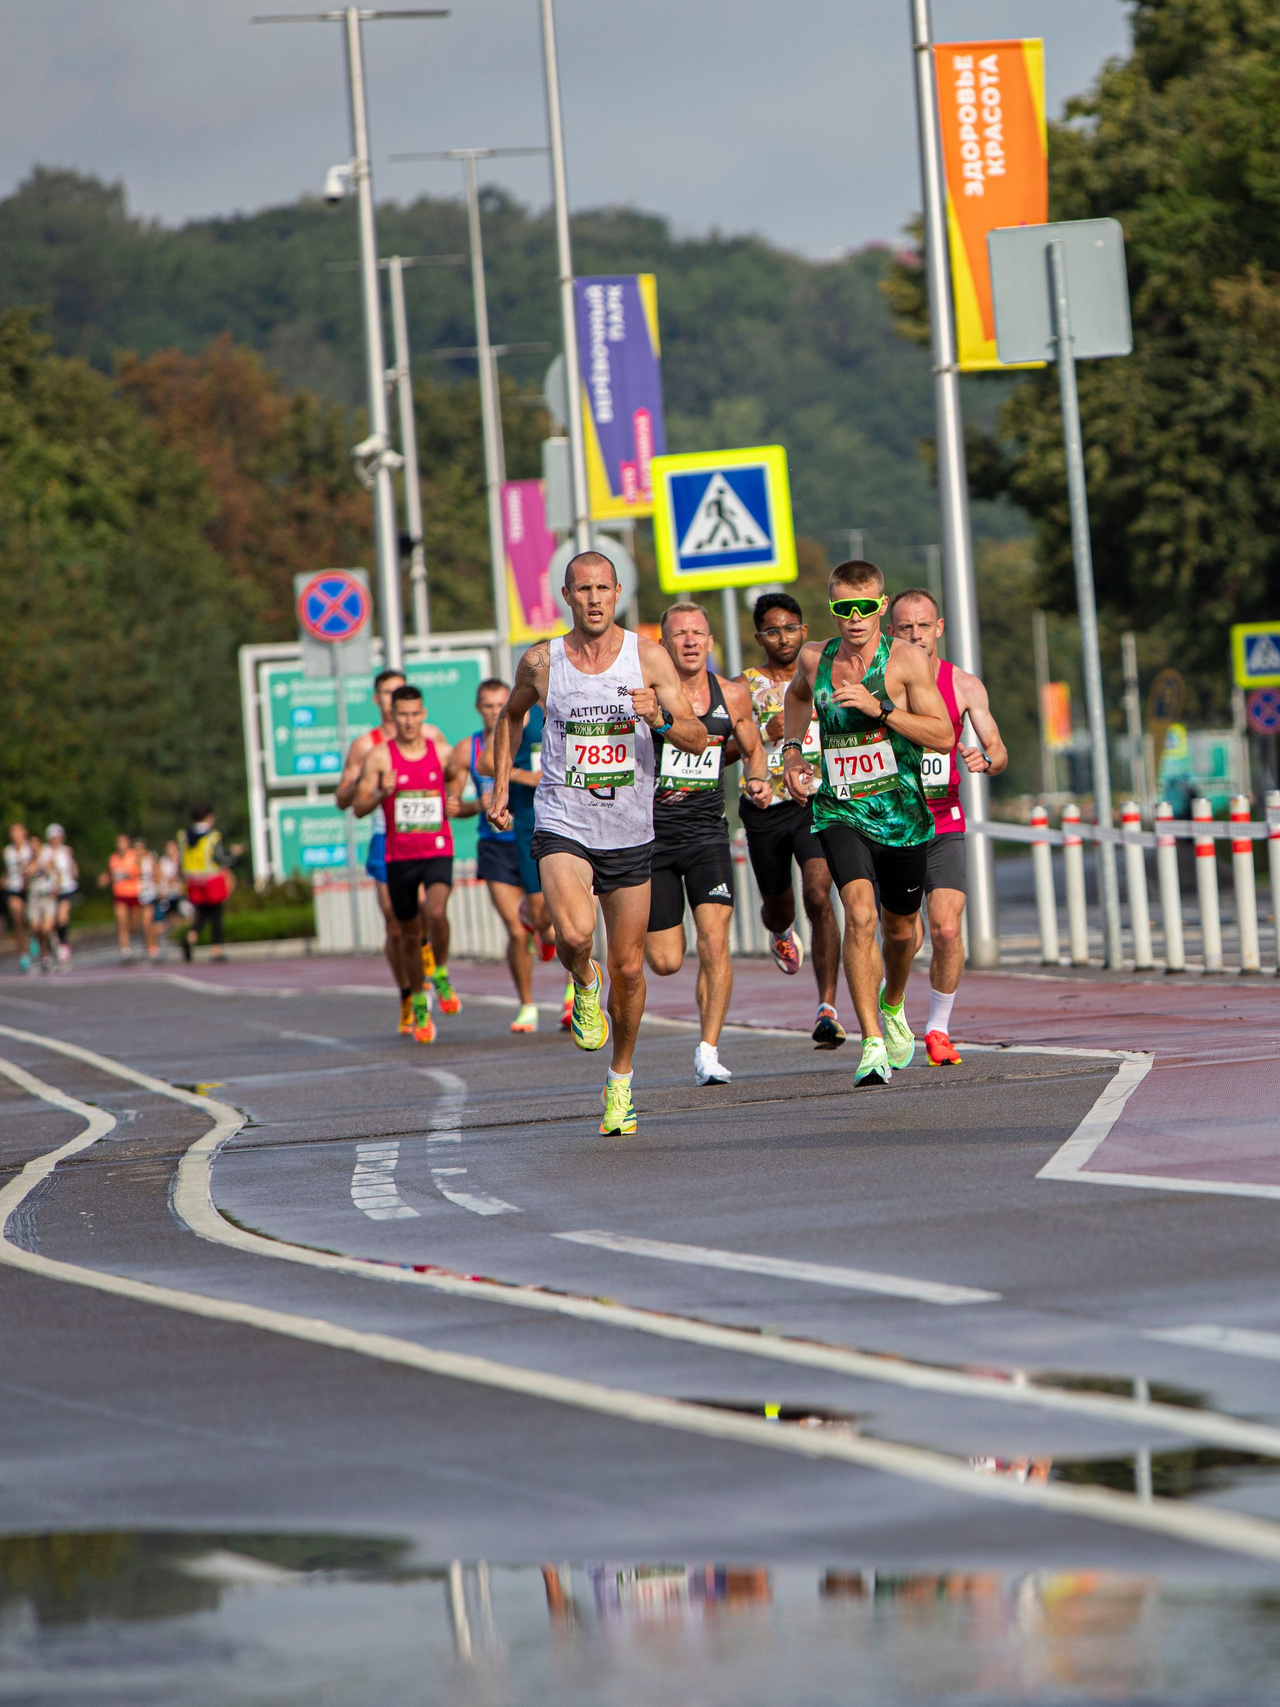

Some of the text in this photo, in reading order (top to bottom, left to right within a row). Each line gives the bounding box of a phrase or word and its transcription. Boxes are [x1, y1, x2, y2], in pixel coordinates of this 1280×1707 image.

[978, 53, 1006, 177] КРАСОТА
[953, 54, 986, 198] ЗДОРОВЬЕ
[607, 284, 625, 342] ПАРК
[570, 704, 625, 718] ALTITUDE
[574, 743, 627, 765] 7830
[671, 749, 713, 768] 7174
[770, 756, 777, 764] A
[834, 751, 885, 777] 7701
[921, 757, 942, 775] 00
[574, 774, 582, 785] A
[840, 786, 848, 797] A
